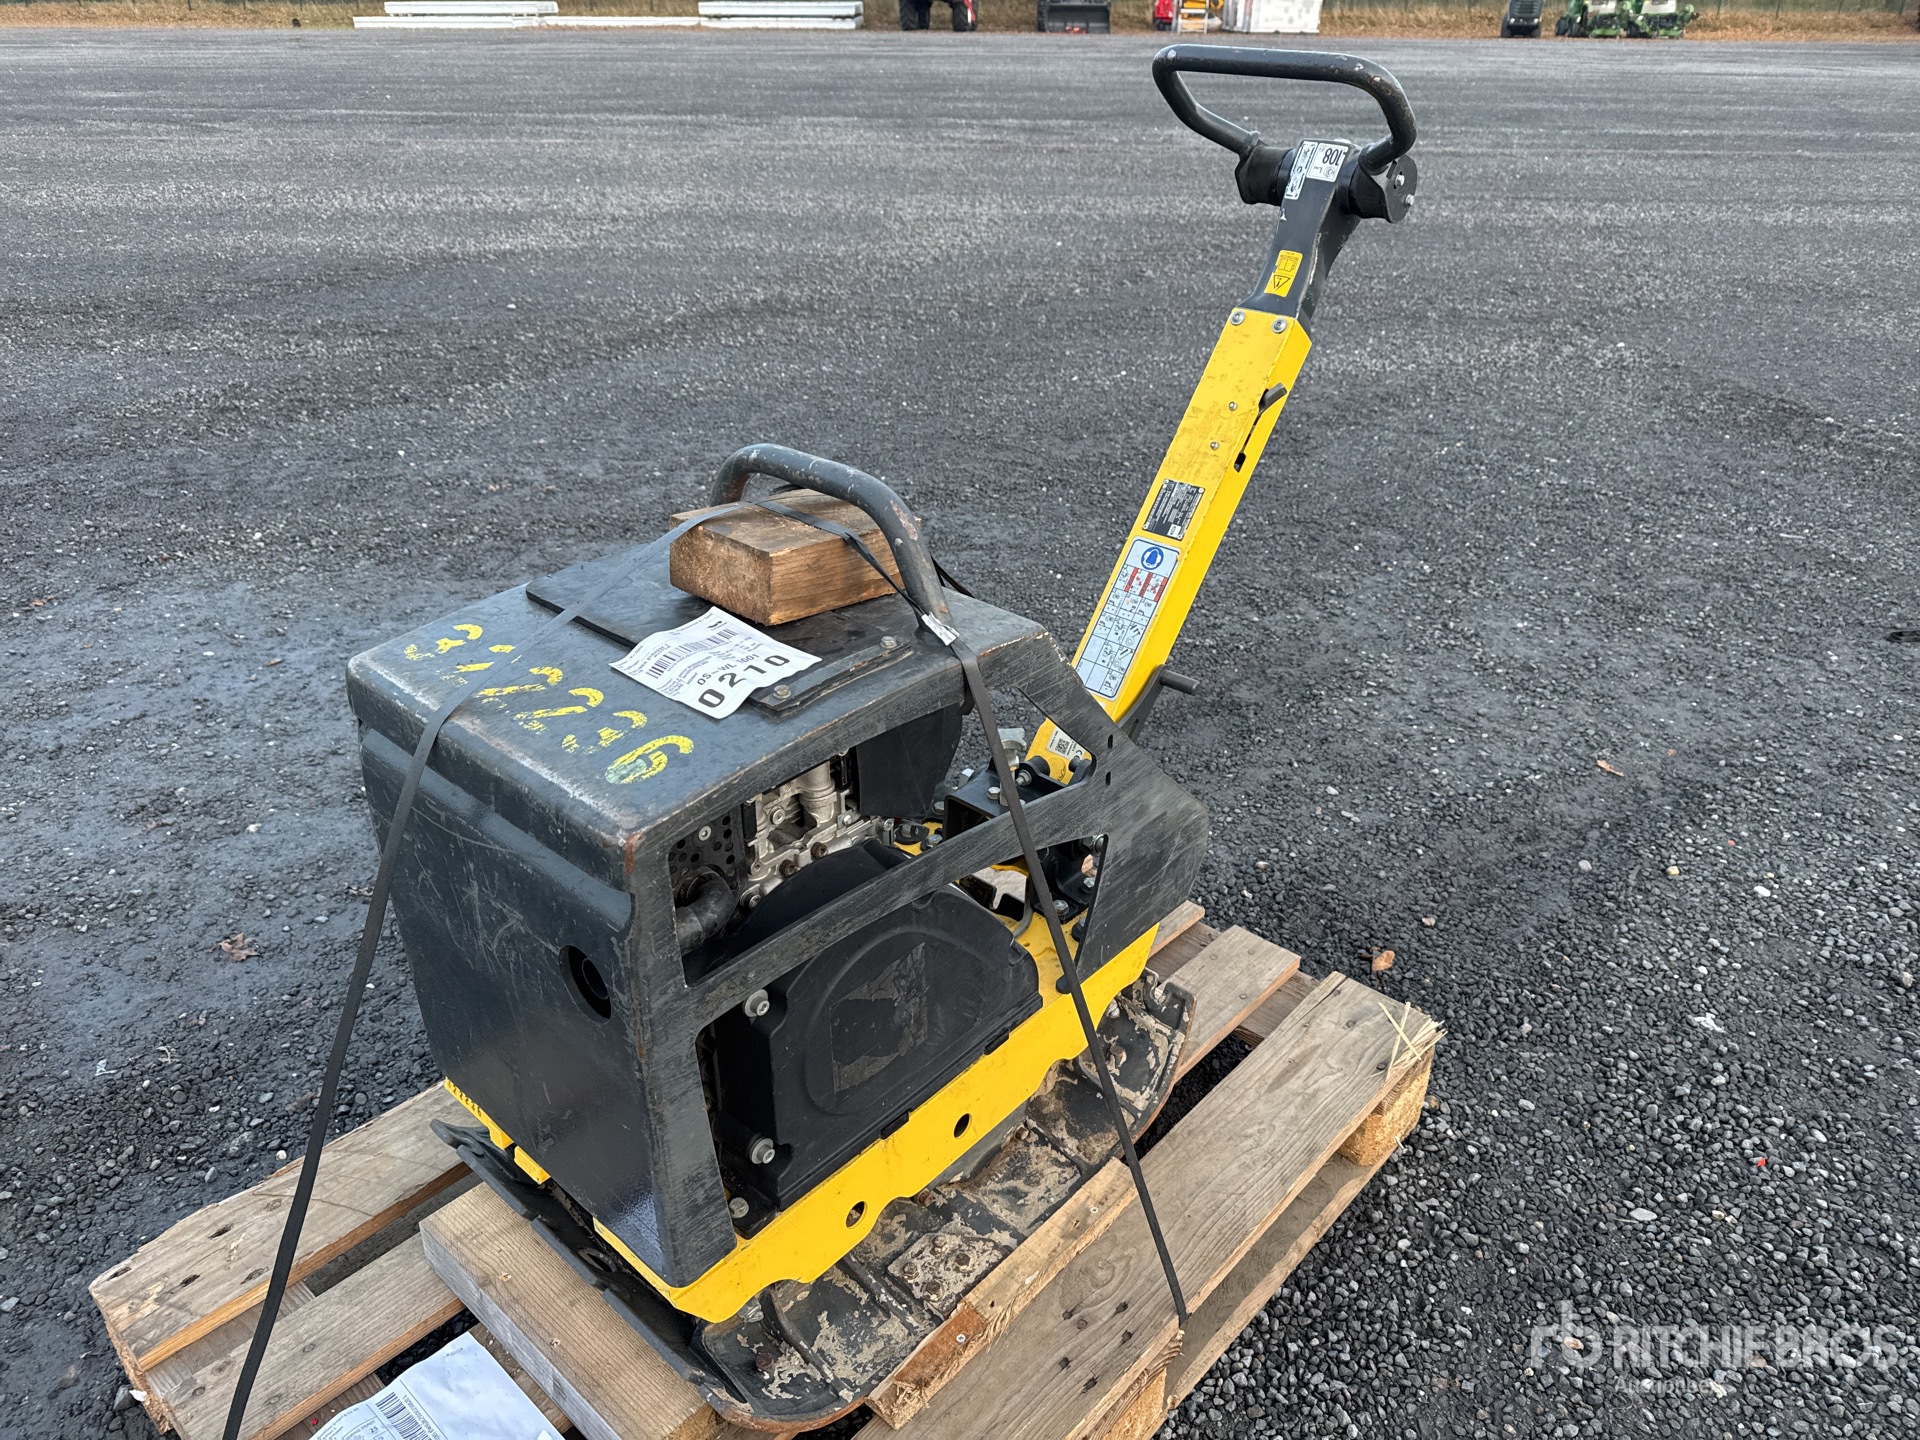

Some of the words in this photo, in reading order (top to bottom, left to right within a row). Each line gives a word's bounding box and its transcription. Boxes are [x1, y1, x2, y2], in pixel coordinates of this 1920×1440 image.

[1322, 148, 1344, 166] 108
[736, 654, 760, 663] 1001
[698, 655, 790, 708] 0210
